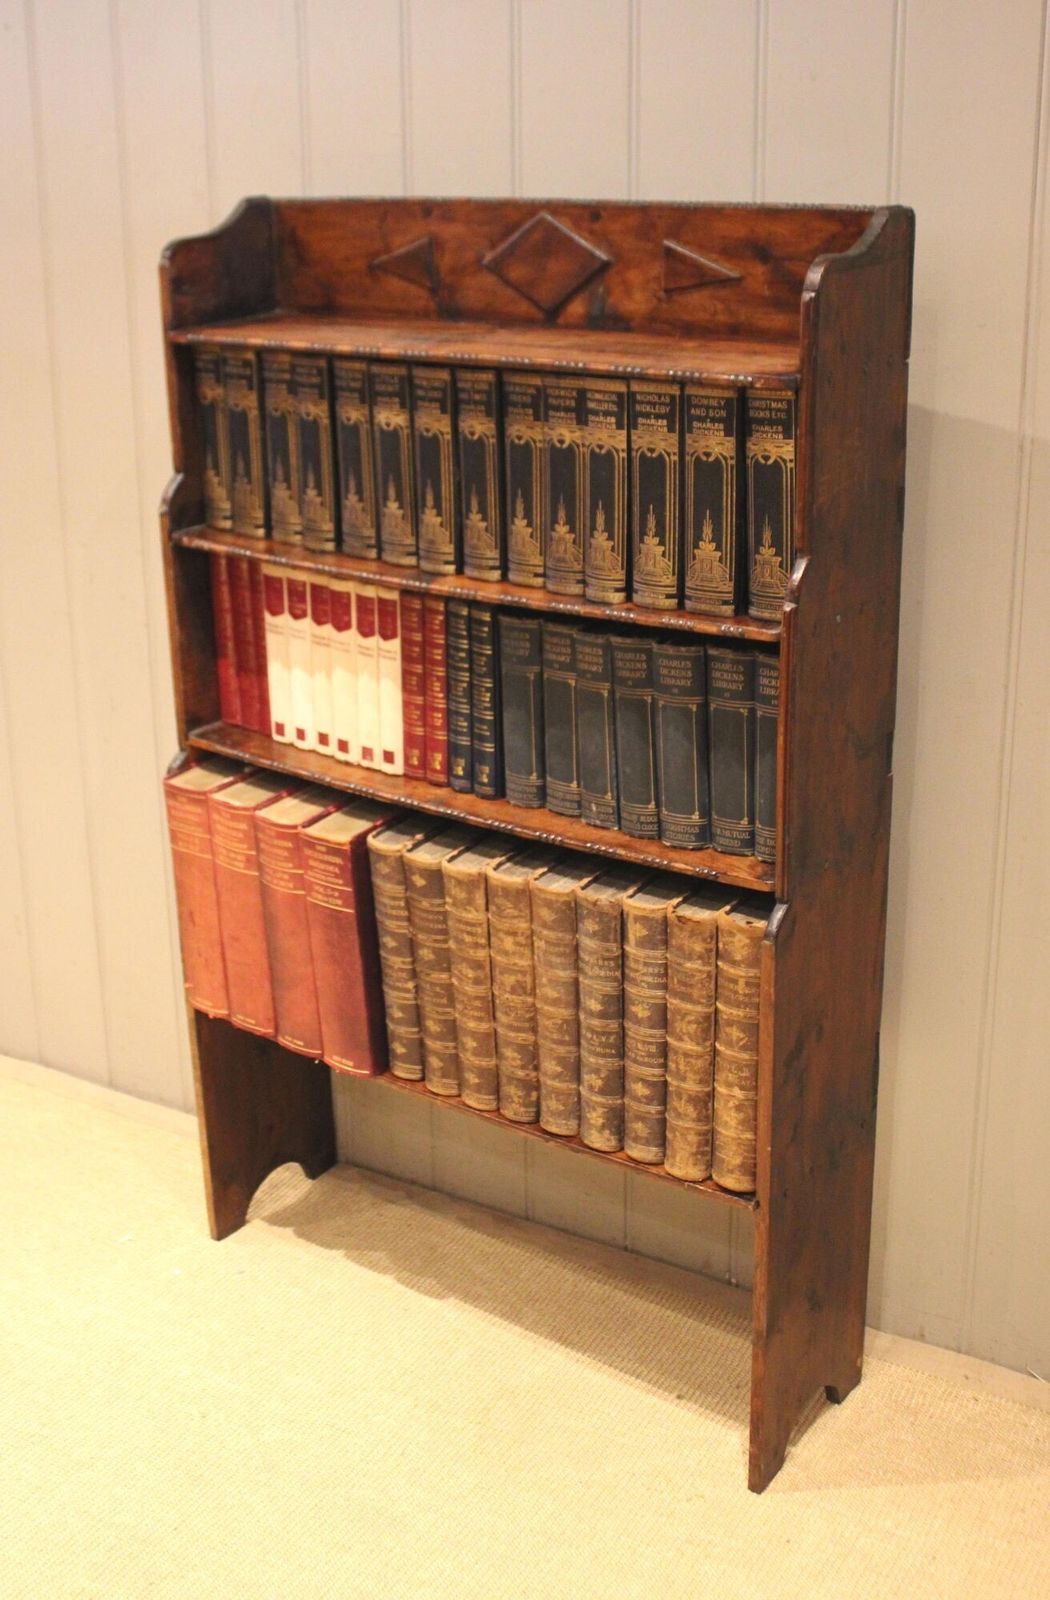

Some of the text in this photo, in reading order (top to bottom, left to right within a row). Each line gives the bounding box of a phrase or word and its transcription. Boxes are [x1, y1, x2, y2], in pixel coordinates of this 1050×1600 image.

[636, 393, 670, 403] NICHOLAS
[691, 396, 727, 407] DOMBEY
[635, 403, 671, 413] NICKLEBY
[690, 407, 727, 417] AND SON
[637, 416, 668, 425] CHARLES
[692, 421, 725, 430] CHARLES
[692, 428, 725, 437] DICKENS
[752, 423, 783, 432] CHARLES
[752, 431, 784, 440] DICKENS
[659, 659, 692, 669] CHARLES
[711, 661, 745, 672] CHARLES
[660, 668, 693, 678] DICKENS
[712, 670, 745, 681] DICKENS
[660, 677, 692, 687] LIBRARY
[712, 679, 745, 690] LIBRARY
[665, 832, 697, 841] STORIES
